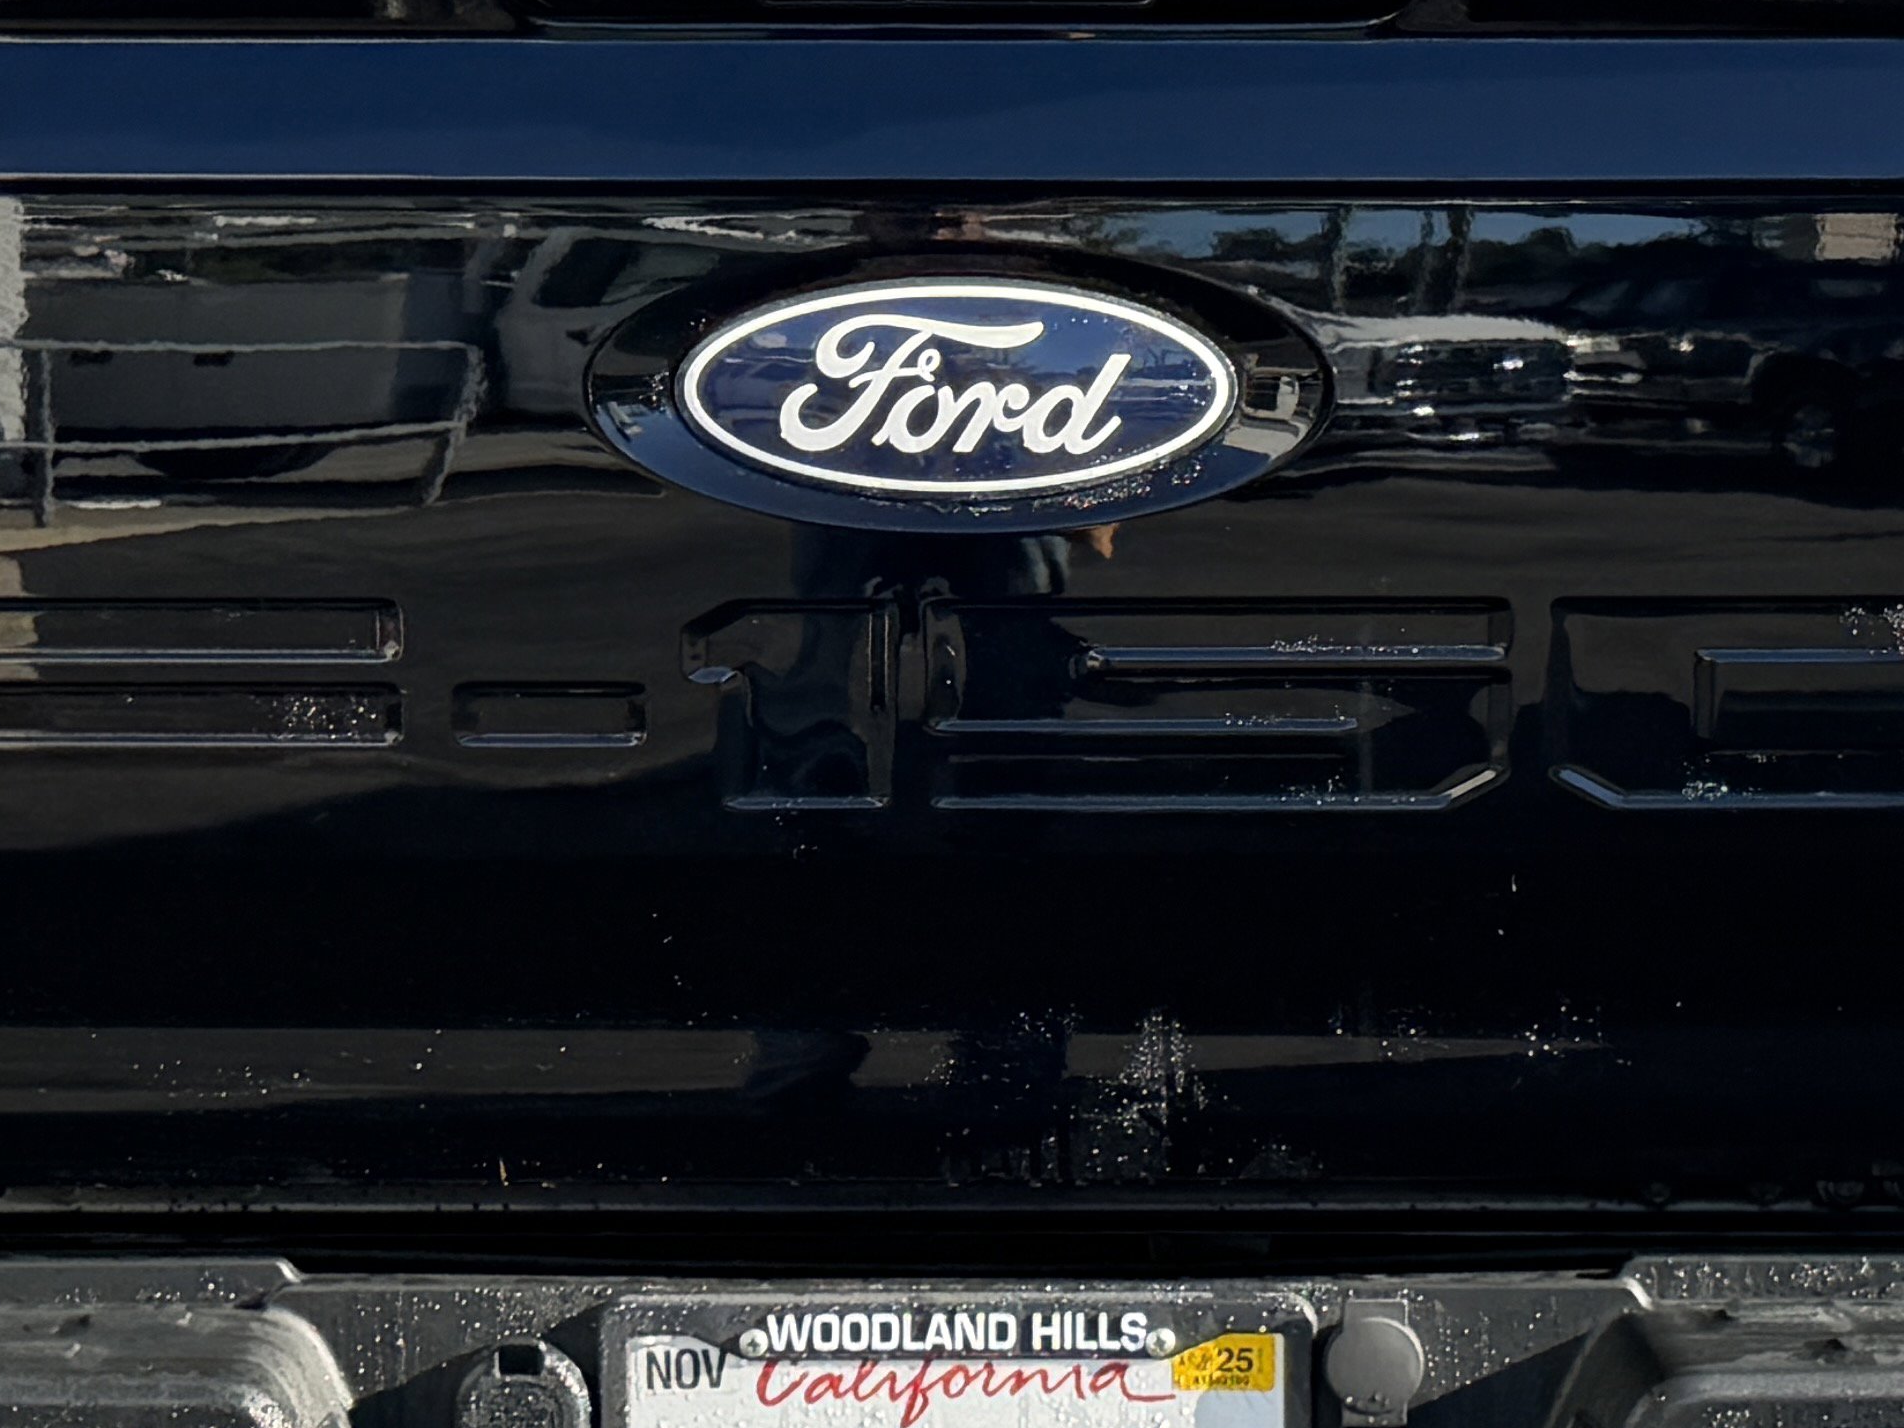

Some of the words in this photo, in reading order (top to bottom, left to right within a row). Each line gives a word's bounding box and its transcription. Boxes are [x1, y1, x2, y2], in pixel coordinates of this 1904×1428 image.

[778, 313, 1132, 455] Ford
[767, 1312, 1018, 1352] WOODLAND
[1031, 1311, 1148, 1352] HILLS
[645, 1347, 728, 1391] NOV
